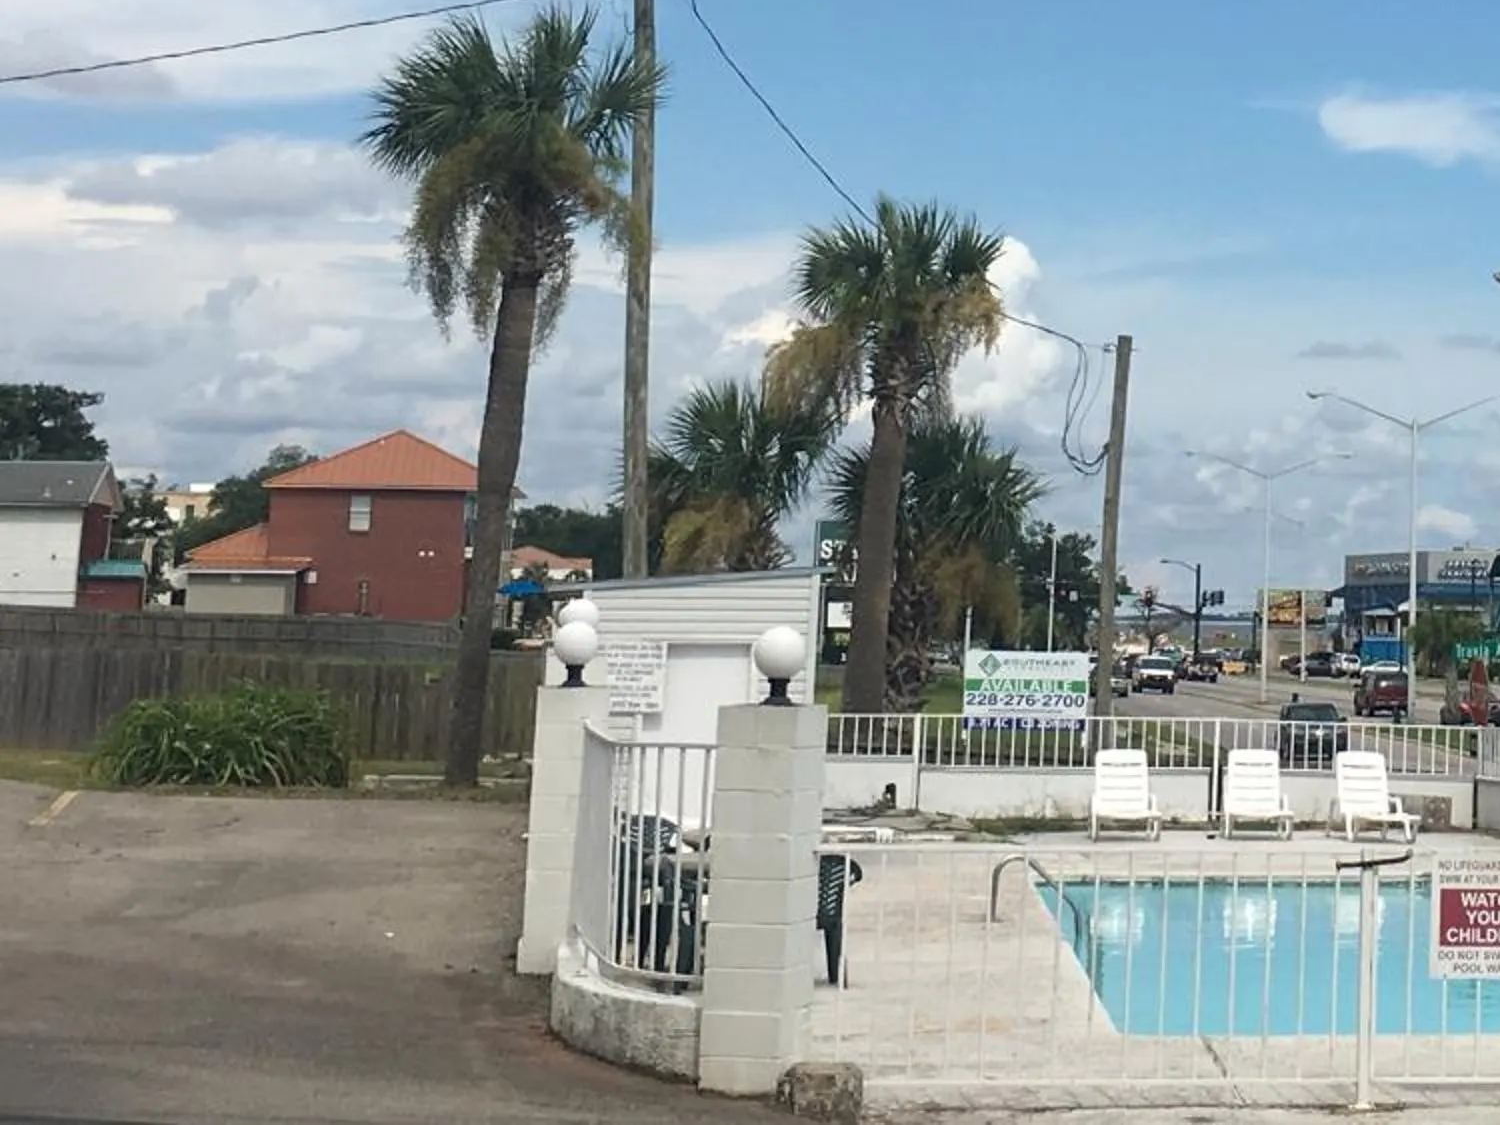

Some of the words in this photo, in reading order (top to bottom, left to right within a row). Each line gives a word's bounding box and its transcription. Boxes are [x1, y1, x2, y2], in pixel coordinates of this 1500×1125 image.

[980, 679, 1073, 693] AVAILABLE
[966, 693, 1085, 708] 228-276-2700
[1438, 860, 1452, 871] NO
[1437, 951, 1455, 961] DO
[1457, 951, 1480, 961] NOT
[1453, 963, 1483, 973] POOL
